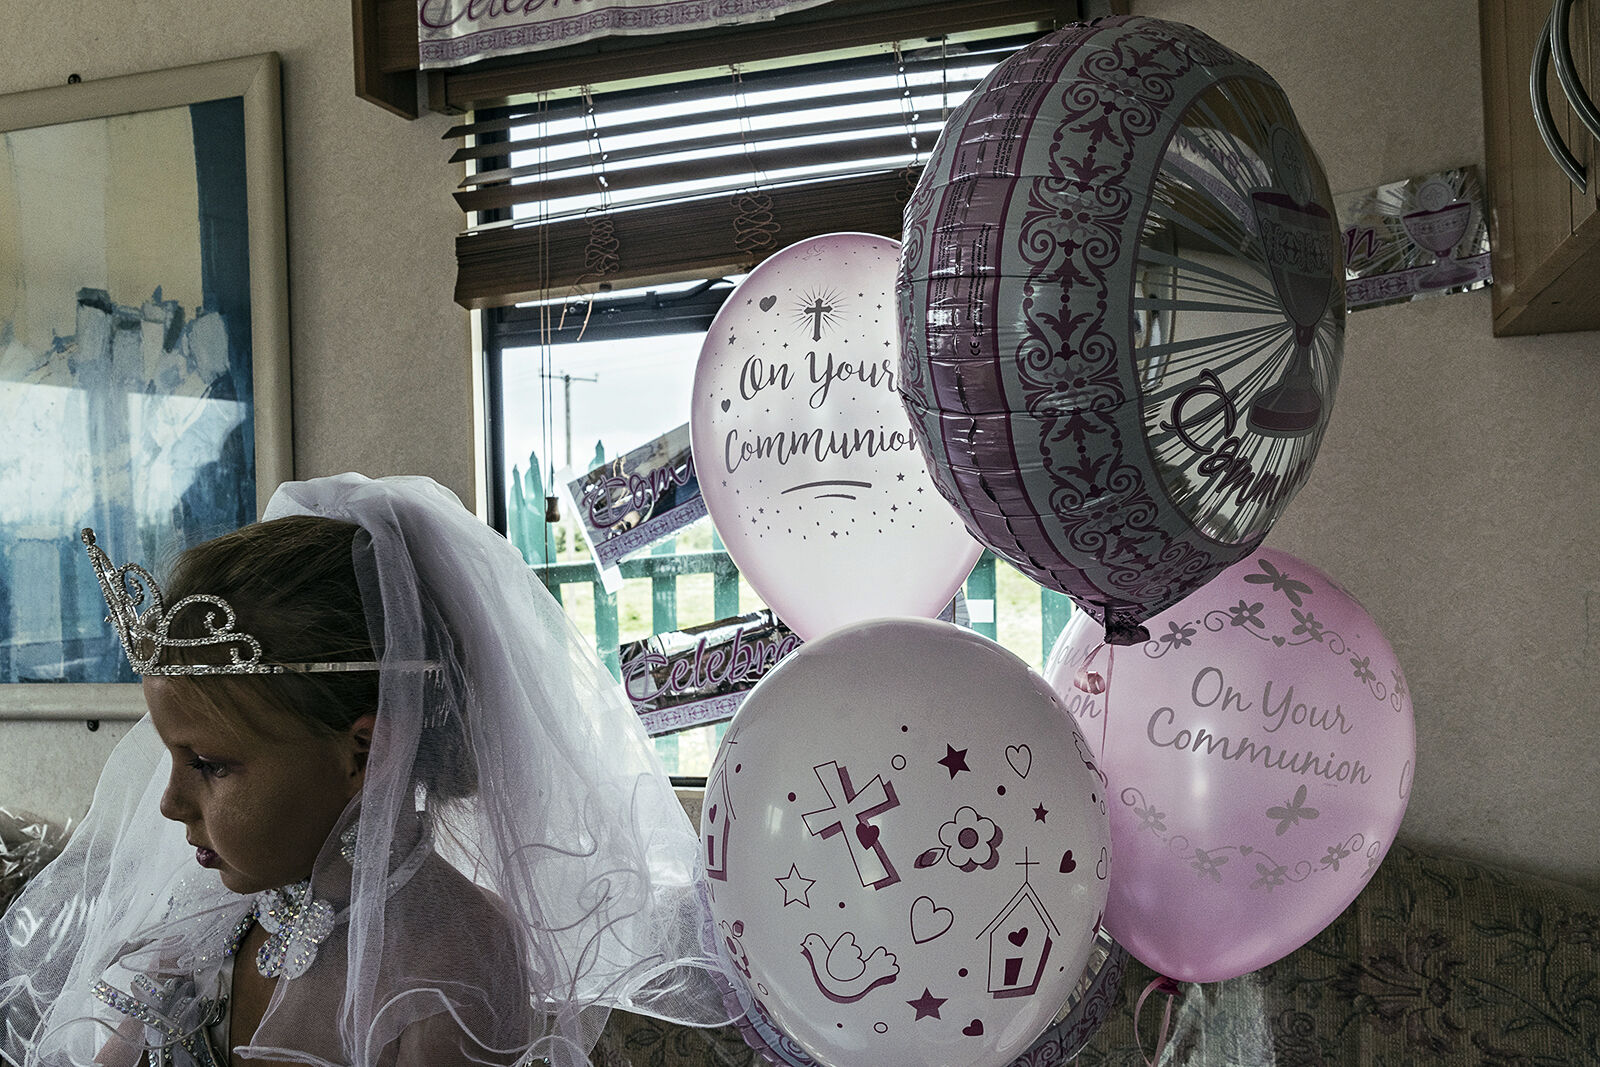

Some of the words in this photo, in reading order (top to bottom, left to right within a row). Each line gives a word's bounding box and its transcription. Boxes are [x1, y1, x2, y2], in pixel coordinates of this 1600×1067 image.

[739, 354, 796, 401] On
[804, 350, 898, 409] Your
[1191, 666, 1252, 712] On
[1261, 680, 1354, 735] Your
[1146, 706, 1372, 785] Communion
